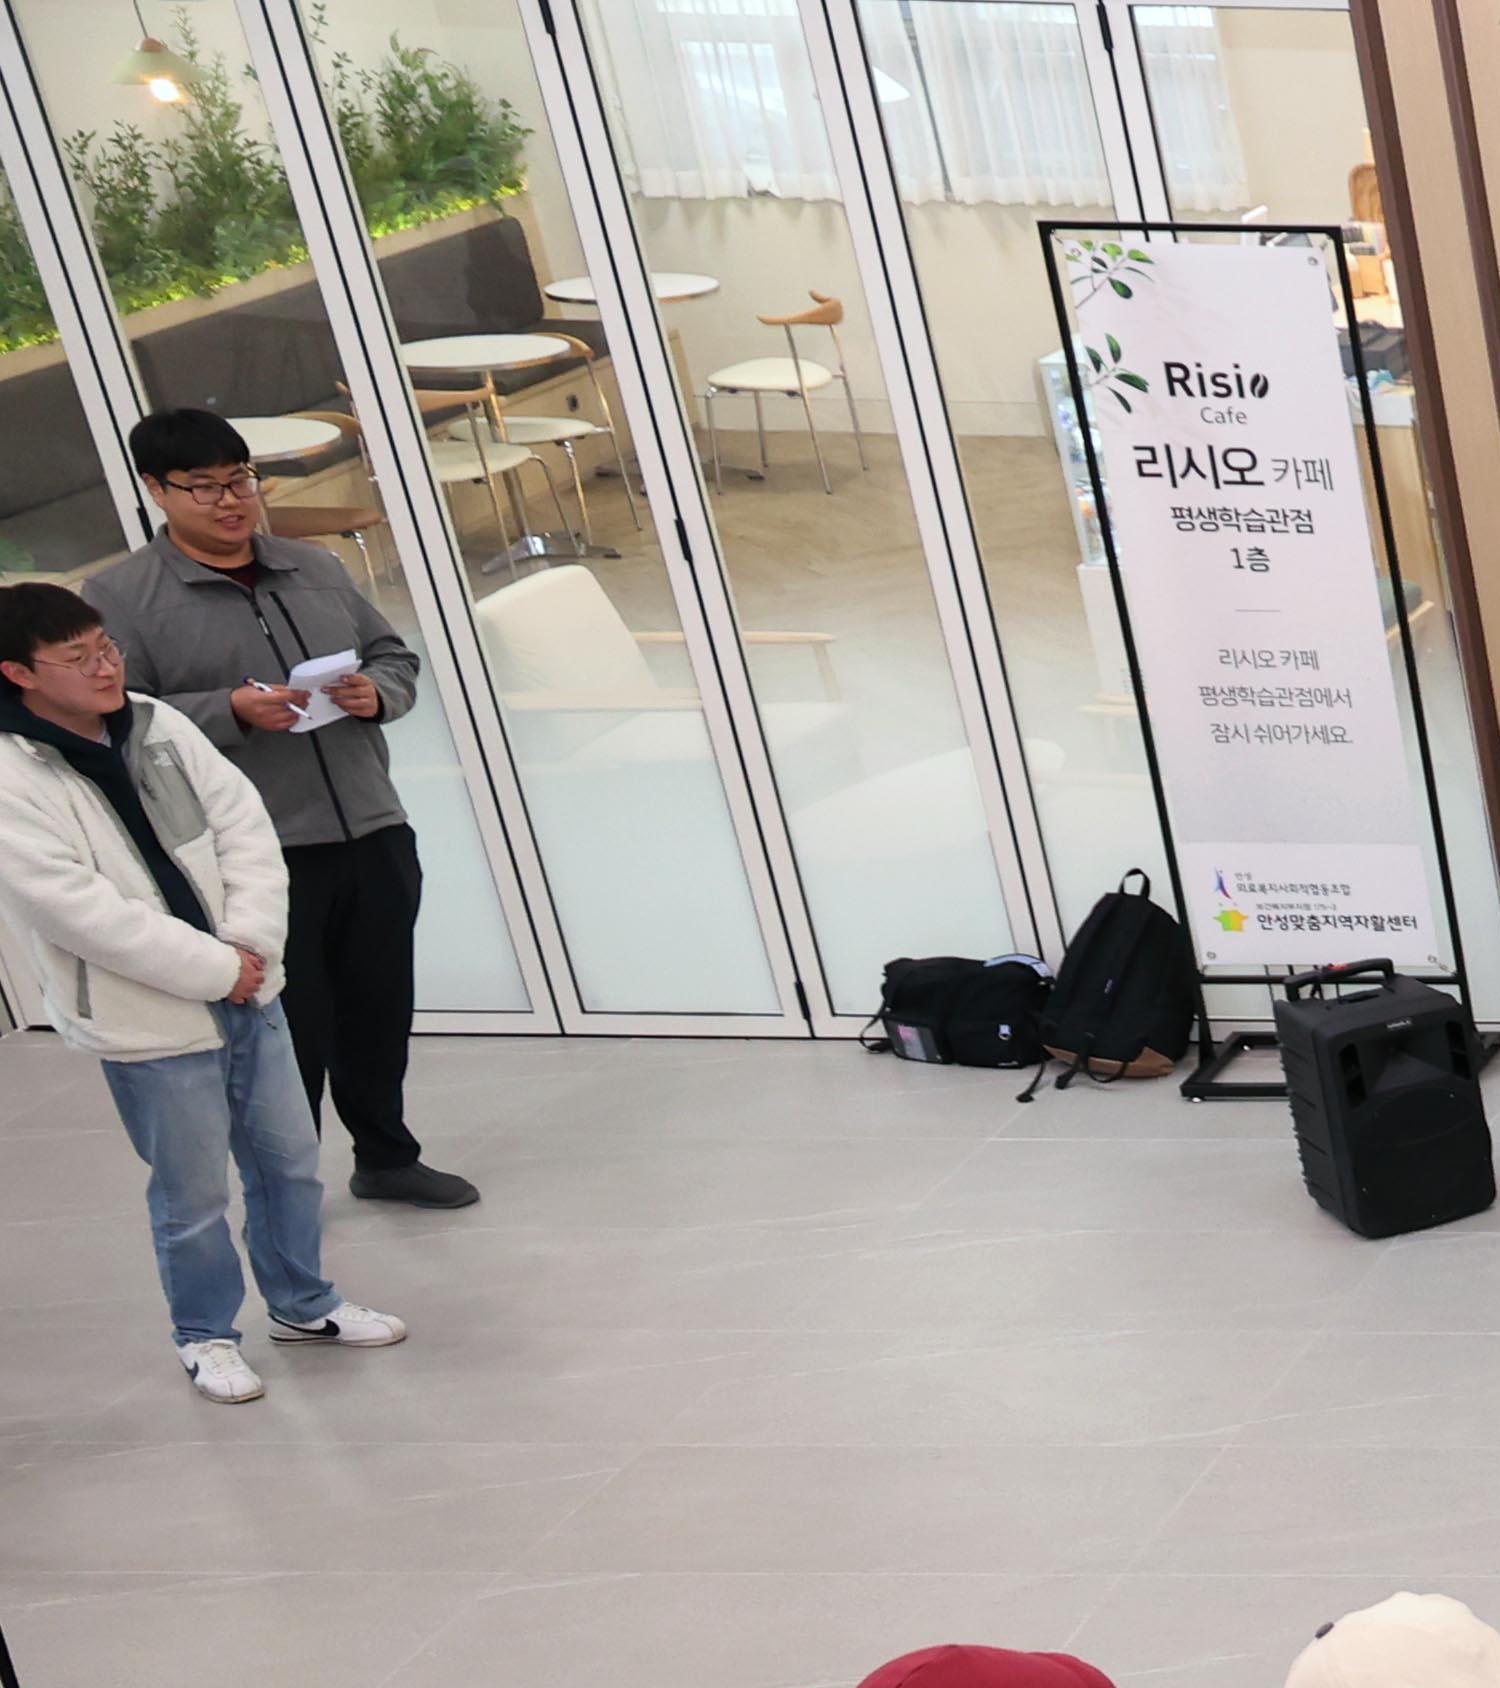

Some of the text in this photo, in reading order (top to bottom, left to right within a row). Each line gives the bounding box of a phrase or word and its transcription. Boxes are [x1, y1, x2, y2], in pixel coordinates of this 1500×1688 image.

[1200, 406, 1248, 425] Cafe
[1132, 443, 1335, 491] 리시오 카페
[1170, 506, 1315, 535] 평생학습관점
[1230, 547, 1271, 573] 1층
[1218, 648, 1320, 671] 리시오 카페
[1198, 685, 1354, 709] 평생학습관점에서
[1210, 722, 1251, 745] 잠시
[1256, 914, 1419, 932] 안성맞춤지역자활센터
